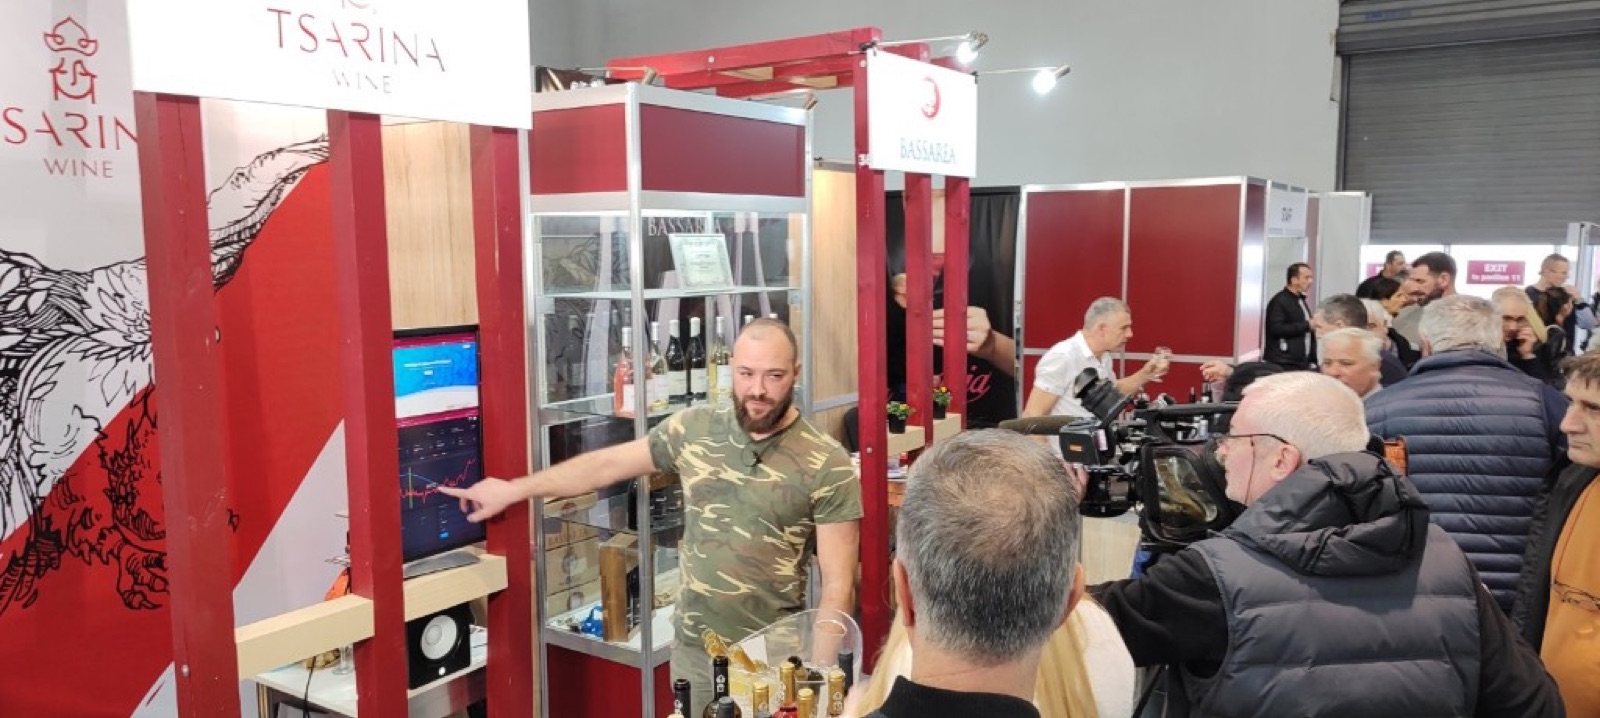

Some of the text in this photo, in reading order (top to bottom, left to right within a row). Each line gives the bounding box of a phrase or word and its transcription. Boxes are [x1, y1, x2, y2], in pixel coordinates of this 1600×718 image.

[267, 8, 445, 72] TSARINA
[332, 68, 392, 94] WINE
[43, 158, 113, 178] WINE
[1484, 263, 1508, 272] EXIT
